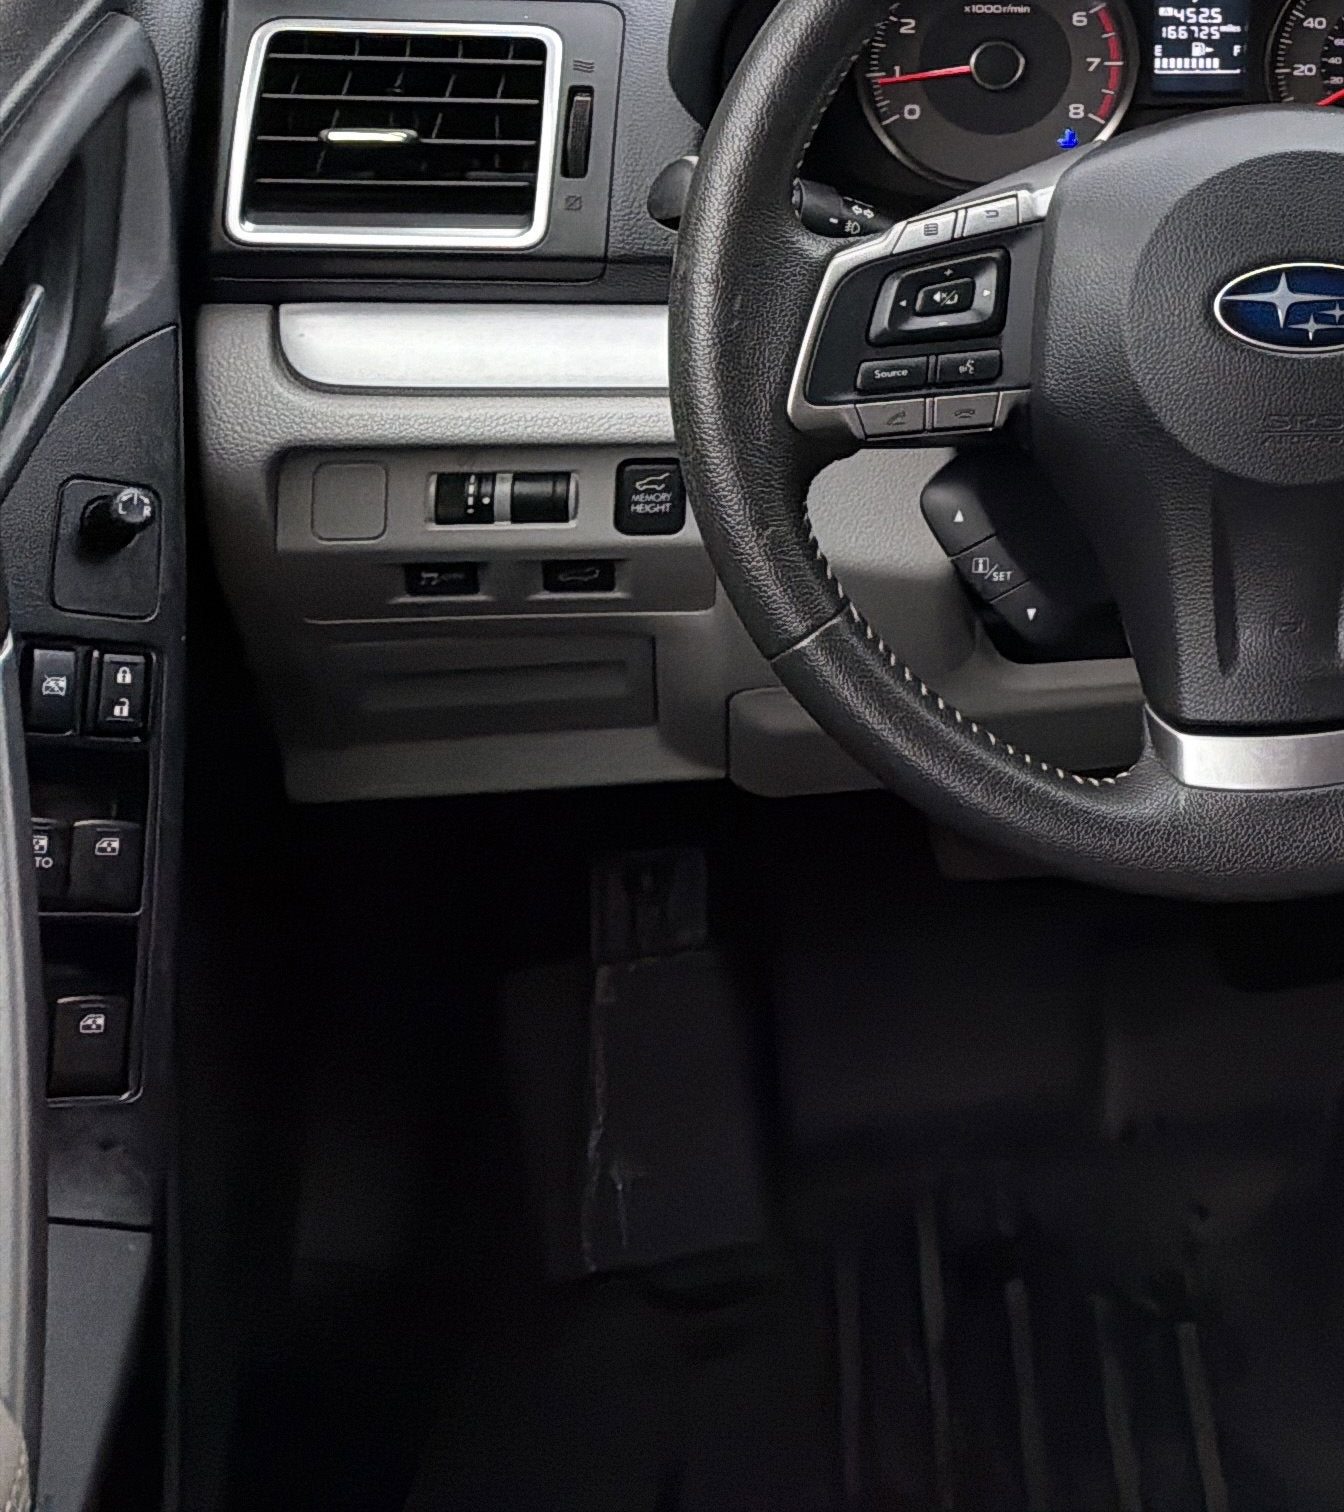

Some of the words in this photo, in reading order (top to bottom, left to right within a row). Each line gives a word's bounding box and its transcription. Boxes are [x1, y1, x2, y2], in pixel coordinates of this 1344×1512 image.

[1072, 12, 1088, 26] 6
[1303, 17, 1326, 29] 40
[899, 19, 916, 34] 2
[1162, 25, 1221, 40] 166725
[1154, 44, 1162, 57] E
[1233, 45, 1241, 57] F
[1086, 57, 1101, 72] 7
[1328, 56, 1342, 64] 40
[893, 65, 900, 78] 1
[1293, 64, 1316, 76] 20
[1329, 76, 1344, 85] 20
[903, 105, 920, 120] 0
[1068, 103, 1084, 119] 8
[874, 368, 908, 379] Source
[631, 492, 672, 502] MEMORY
[118, 502, 128, 515] L
[143, 505, 152, 517] R
[631, 503, 672, 513] HEIGHT
[35, 857, 53, 868] TO
